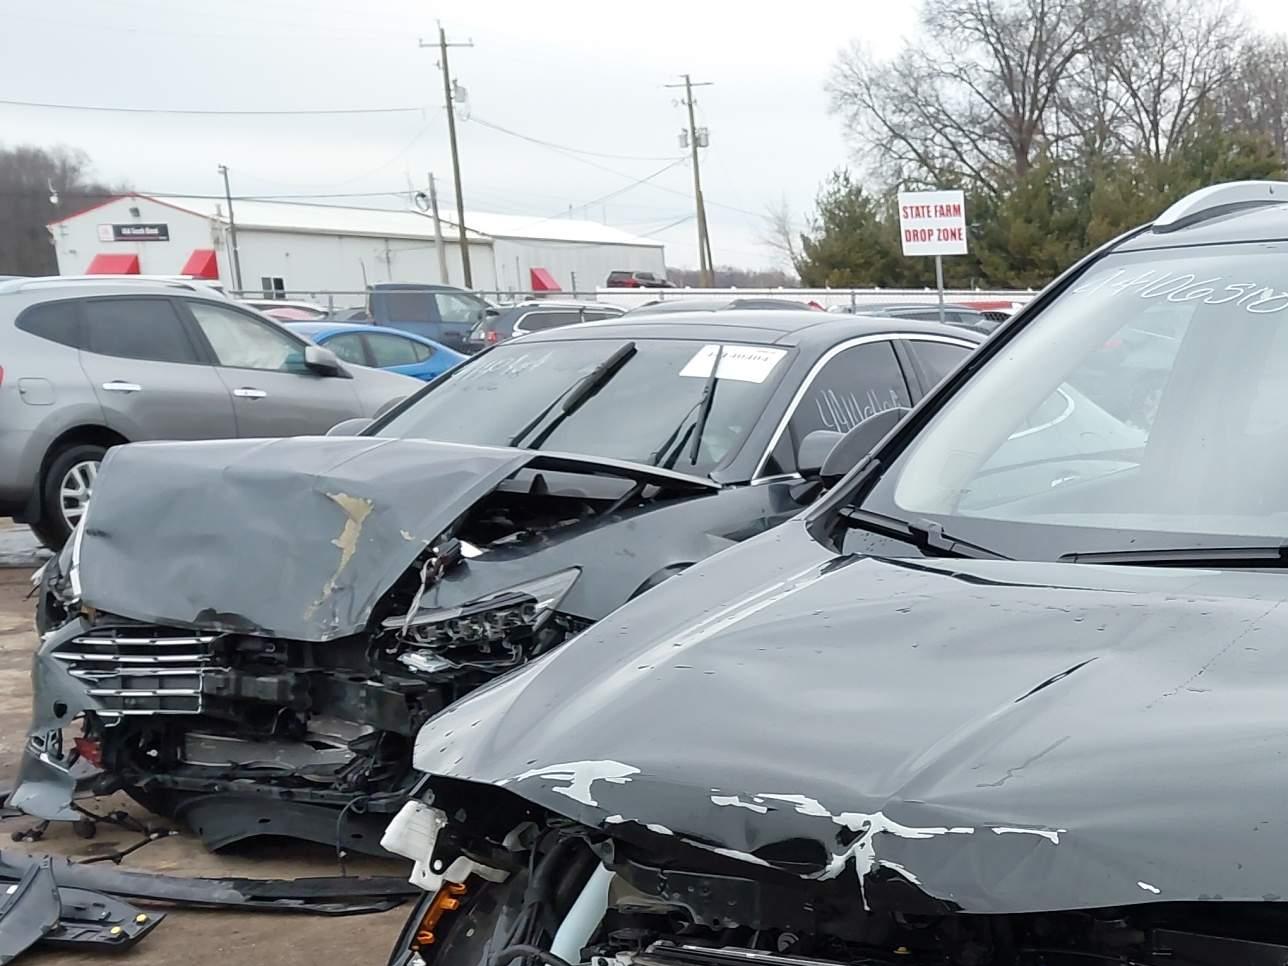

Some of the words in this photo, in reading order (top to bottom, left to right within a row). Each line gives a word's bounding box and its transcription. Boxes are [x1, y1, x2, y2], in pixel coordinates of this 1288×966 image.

[902, 205, 932, 219] STATE
[934, 204, 961, 218] FARM
[904, 229, 934, 242] DROP
[937, 228, 963, 241] ZONE
